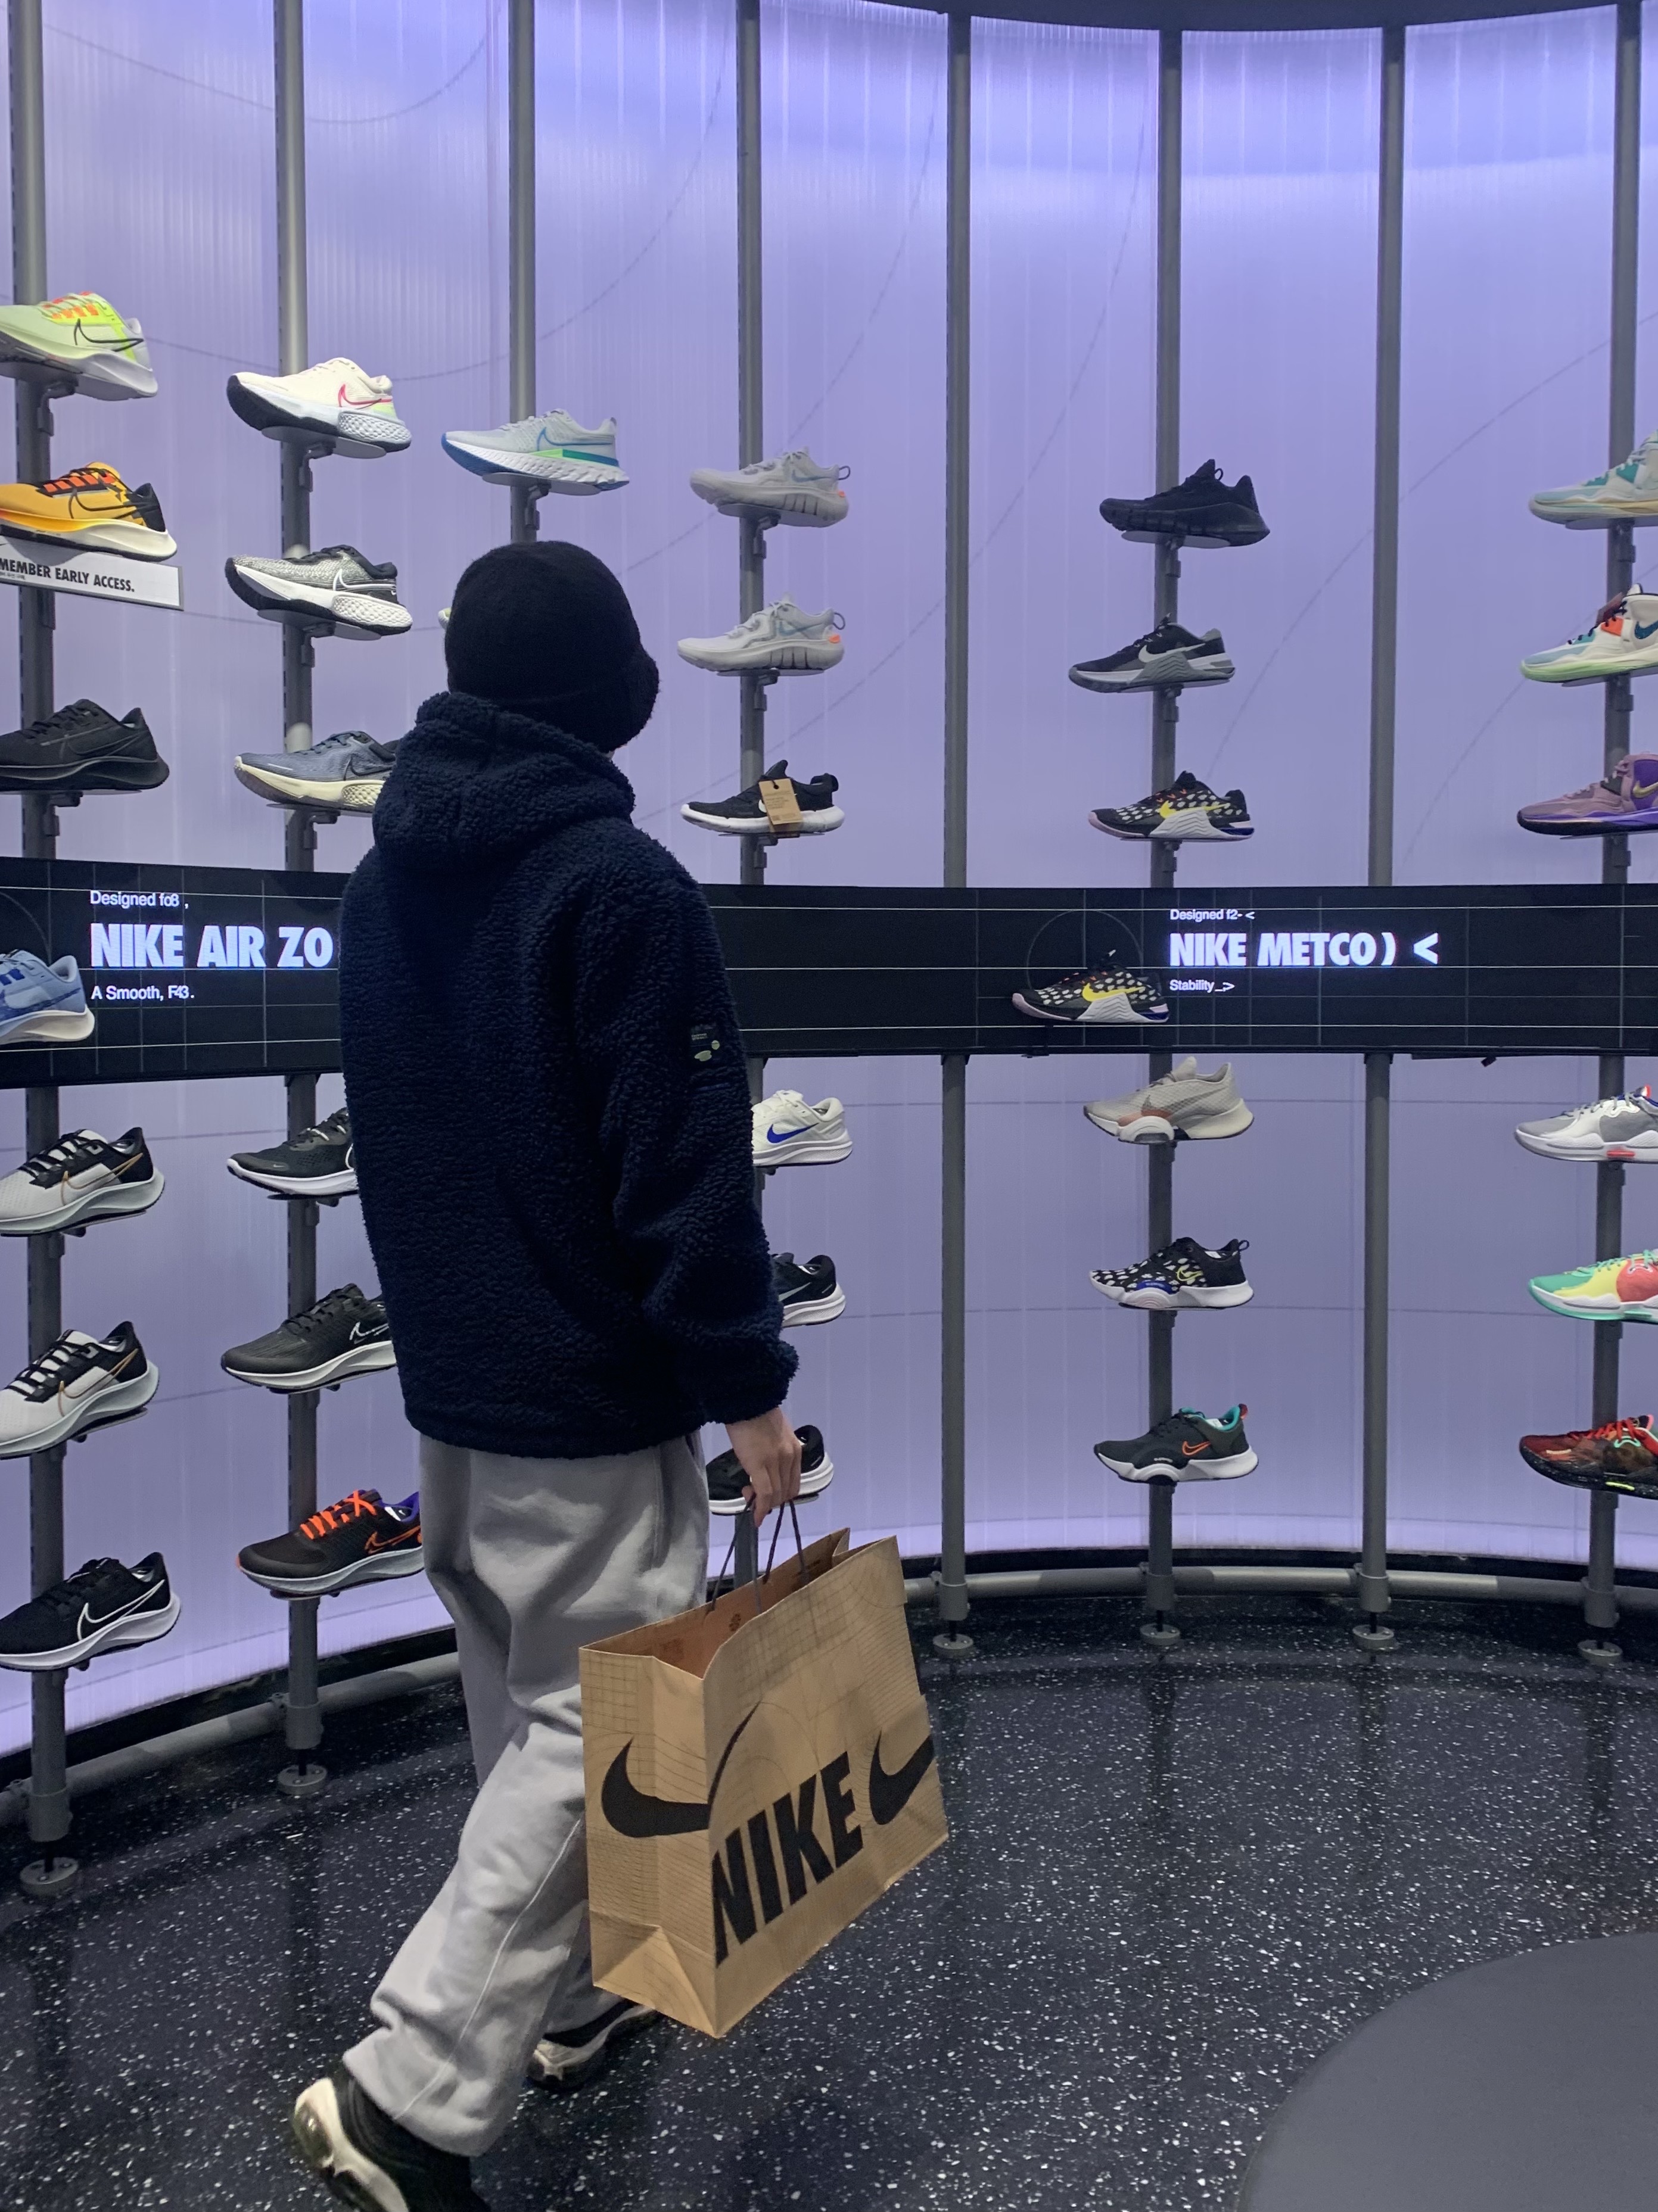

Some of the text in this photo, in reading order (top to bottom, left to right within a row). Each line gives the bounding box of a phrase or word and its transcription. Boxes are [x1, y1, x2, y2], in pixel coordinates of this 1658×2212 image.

[0, 557, 51, 578] MEMBER
[55, 567, 89, 585] EARLY
[94, 574, 135, 592] ACCESS.
[90, 890, 156, 909] Designed
[1170, 909, 1224, 923] Designed
[91, 923, 334, 967] NIKE AIR ZO
[1169, 933, 1247, 966] NIKE
[91, 986, 102, 999] A
[105, 985, 164, 1001] Smooth,
[711, 1751, 863, 1968] NIKE
